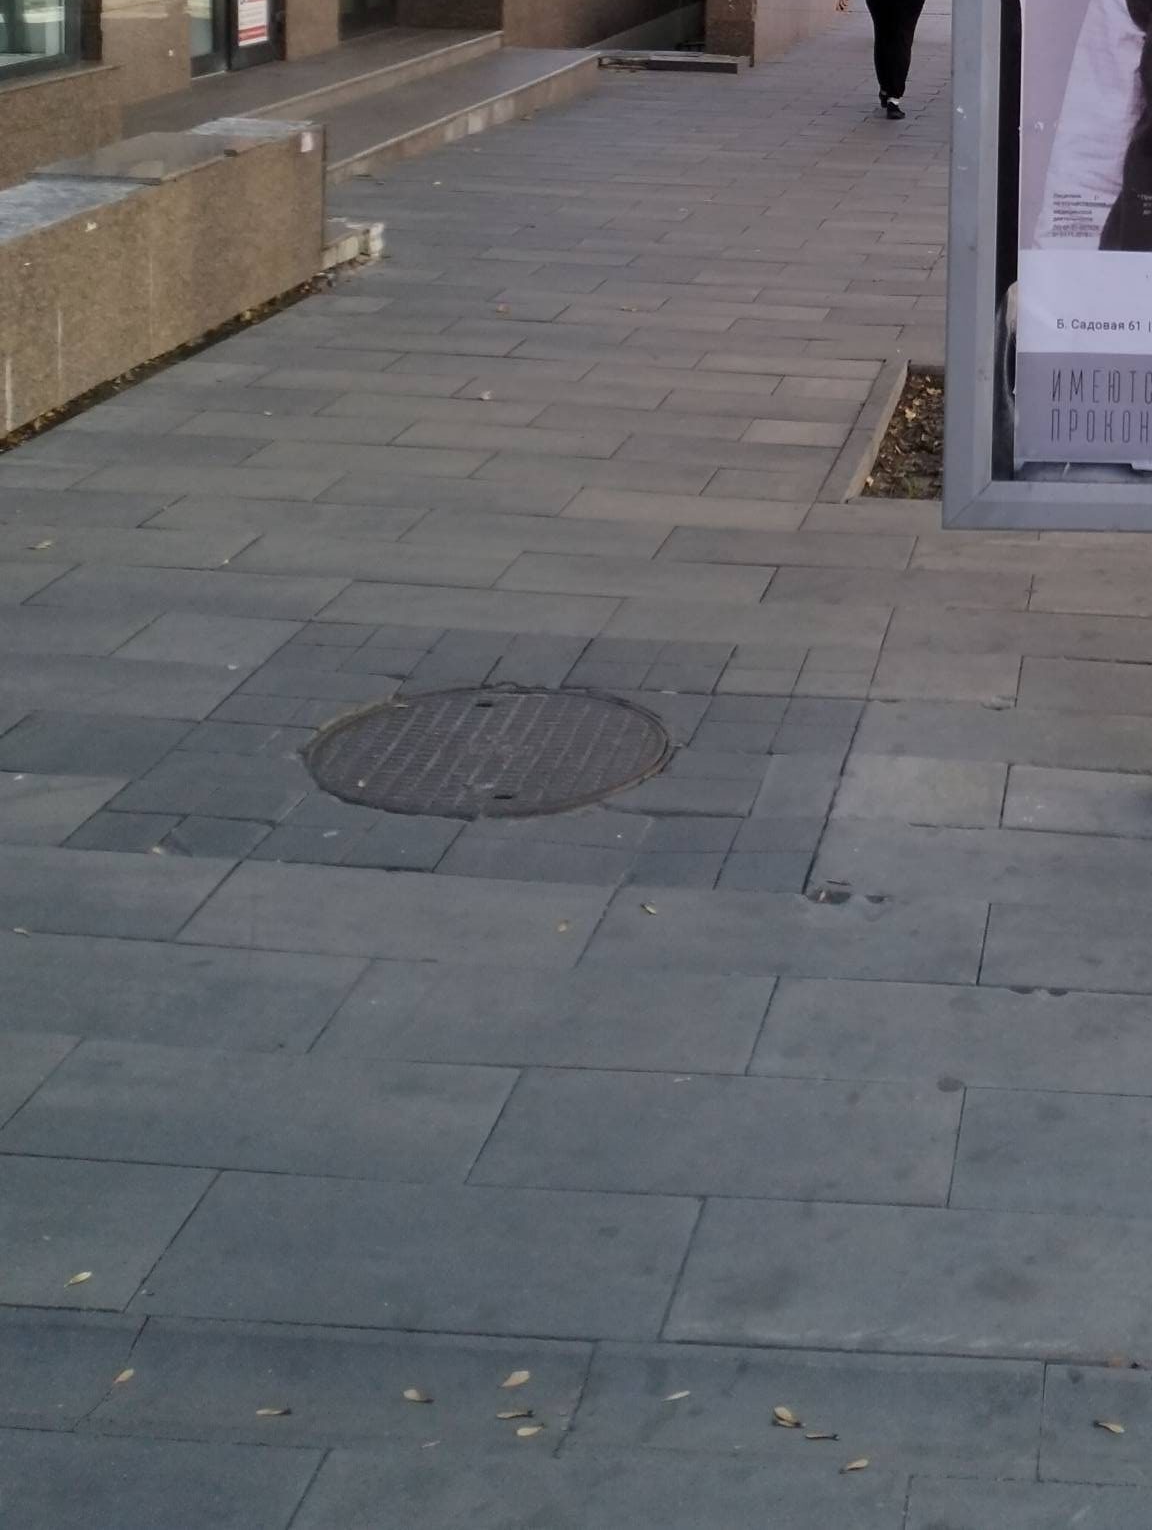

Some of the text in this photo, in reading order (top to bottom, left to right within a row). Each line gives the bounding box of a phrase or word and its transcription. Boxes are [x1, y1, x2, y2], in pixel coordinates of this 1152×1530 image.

[1056, 318, 1068, 330] Б.
[1071, 319, 1125, 333] Садовая
[1128, 320, 1141, 331] 61
